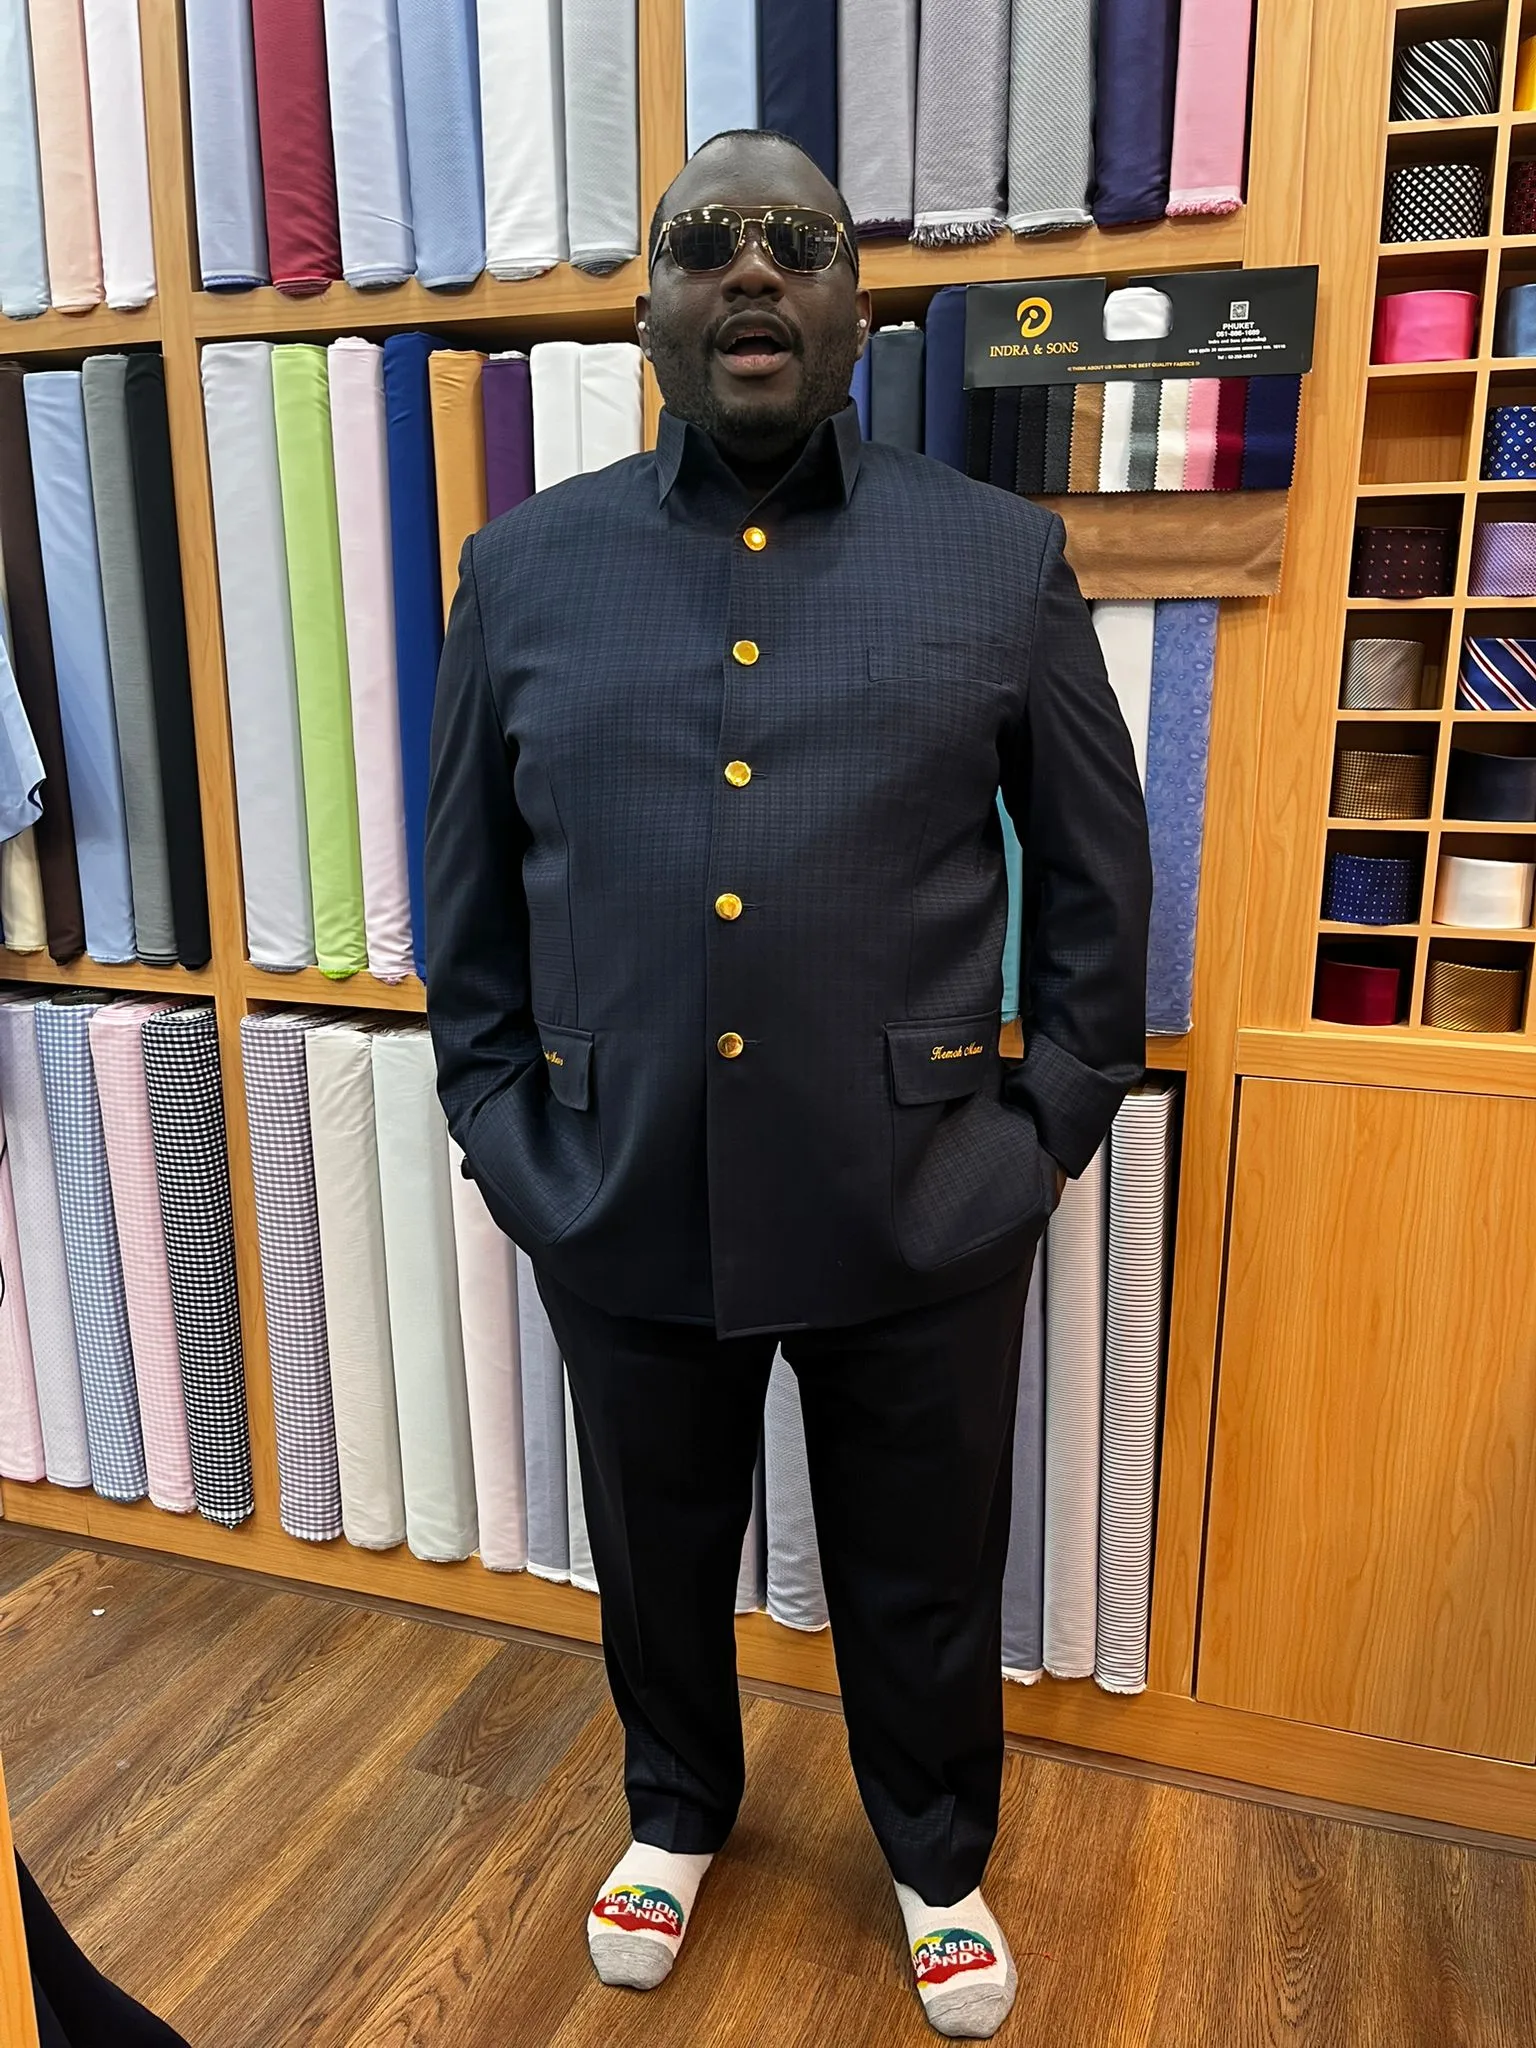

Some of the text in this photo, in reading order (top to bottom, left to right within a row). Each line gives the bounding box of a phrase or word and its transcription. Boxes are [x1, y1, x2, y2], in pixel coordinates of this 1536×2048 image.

[1222, 321, 1255, 330] PHUKET
[990, 342, 1079, 357] INDRA & SONS
[605, 1893, 680, 1925] HARBOR
